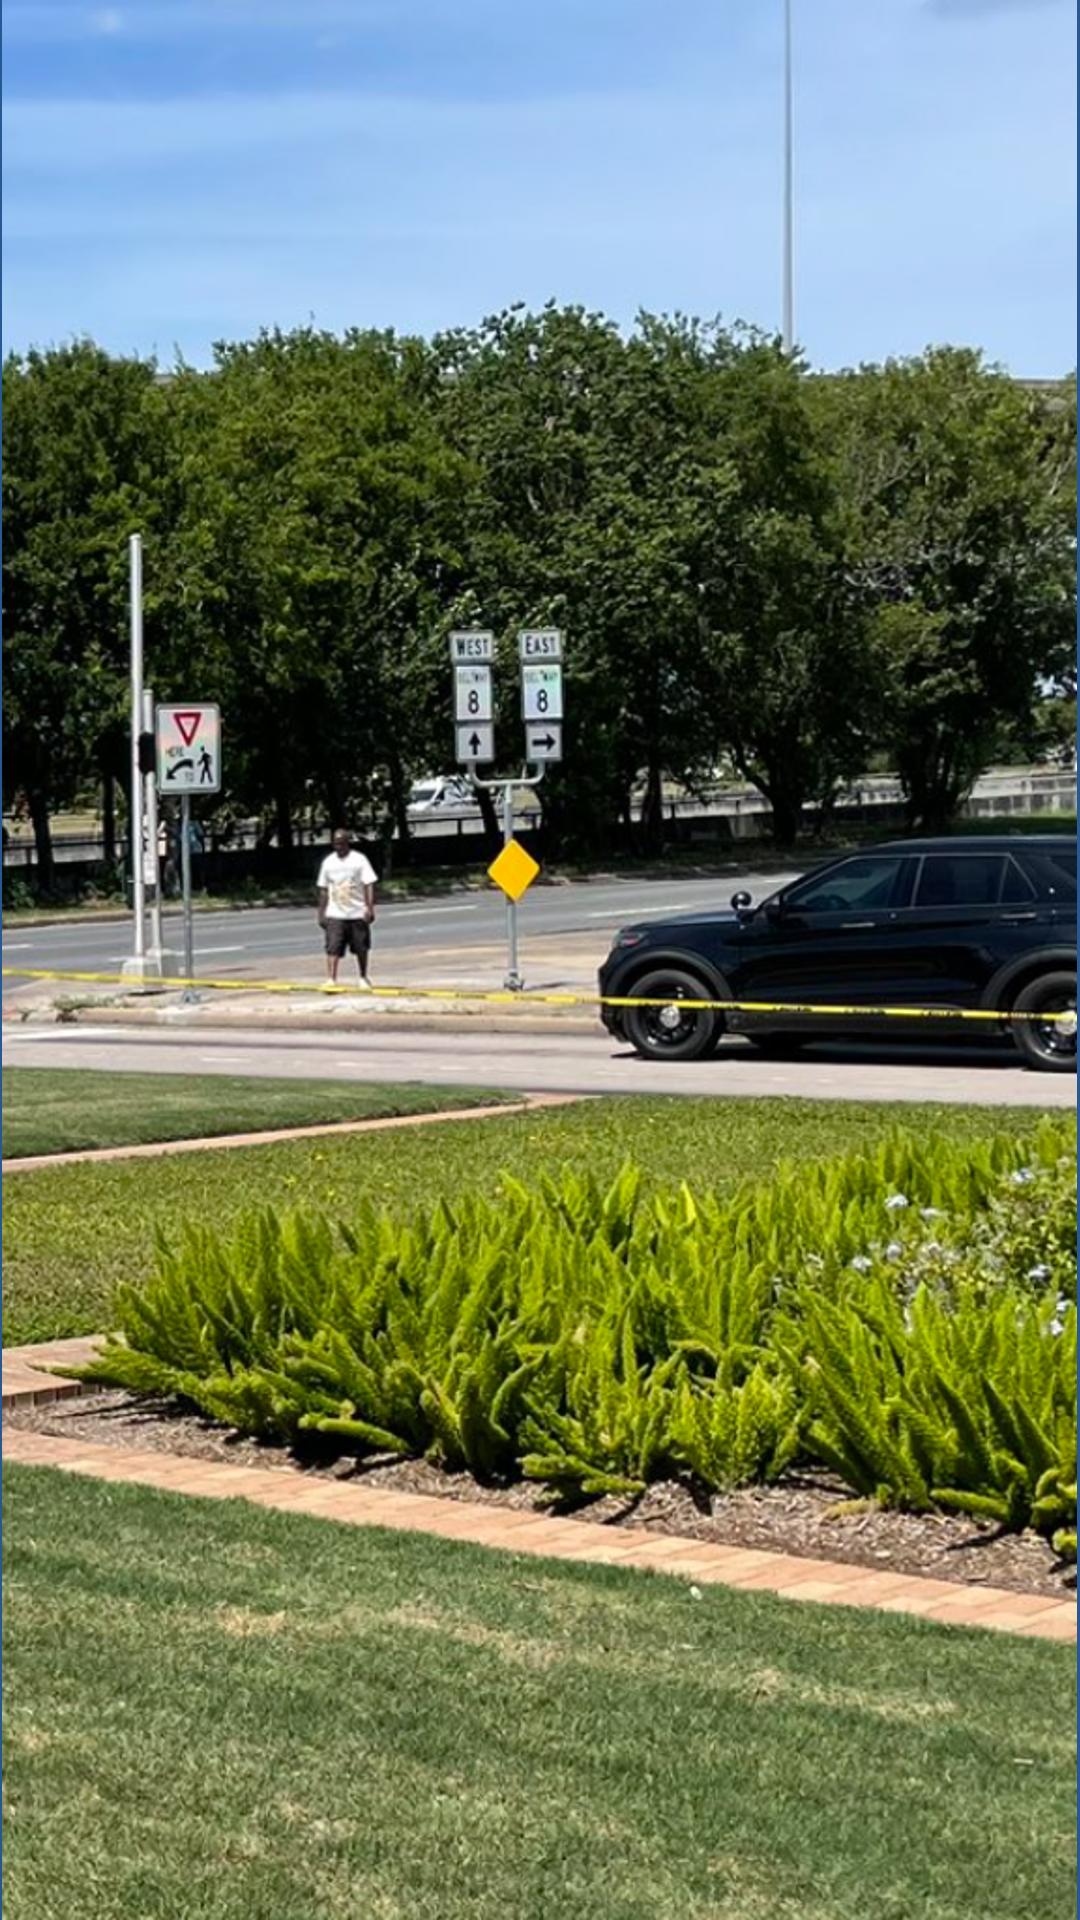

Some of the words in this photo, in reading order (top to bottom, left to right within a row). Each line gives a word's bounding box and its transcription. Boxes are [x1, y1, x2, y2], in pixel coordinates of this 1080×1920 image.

[456, 638, 488, 656] WEST
[526, 635, 556, 654] EAST
[468, 690, 479, 714] 8
[537, 688, 548, 713] 8
